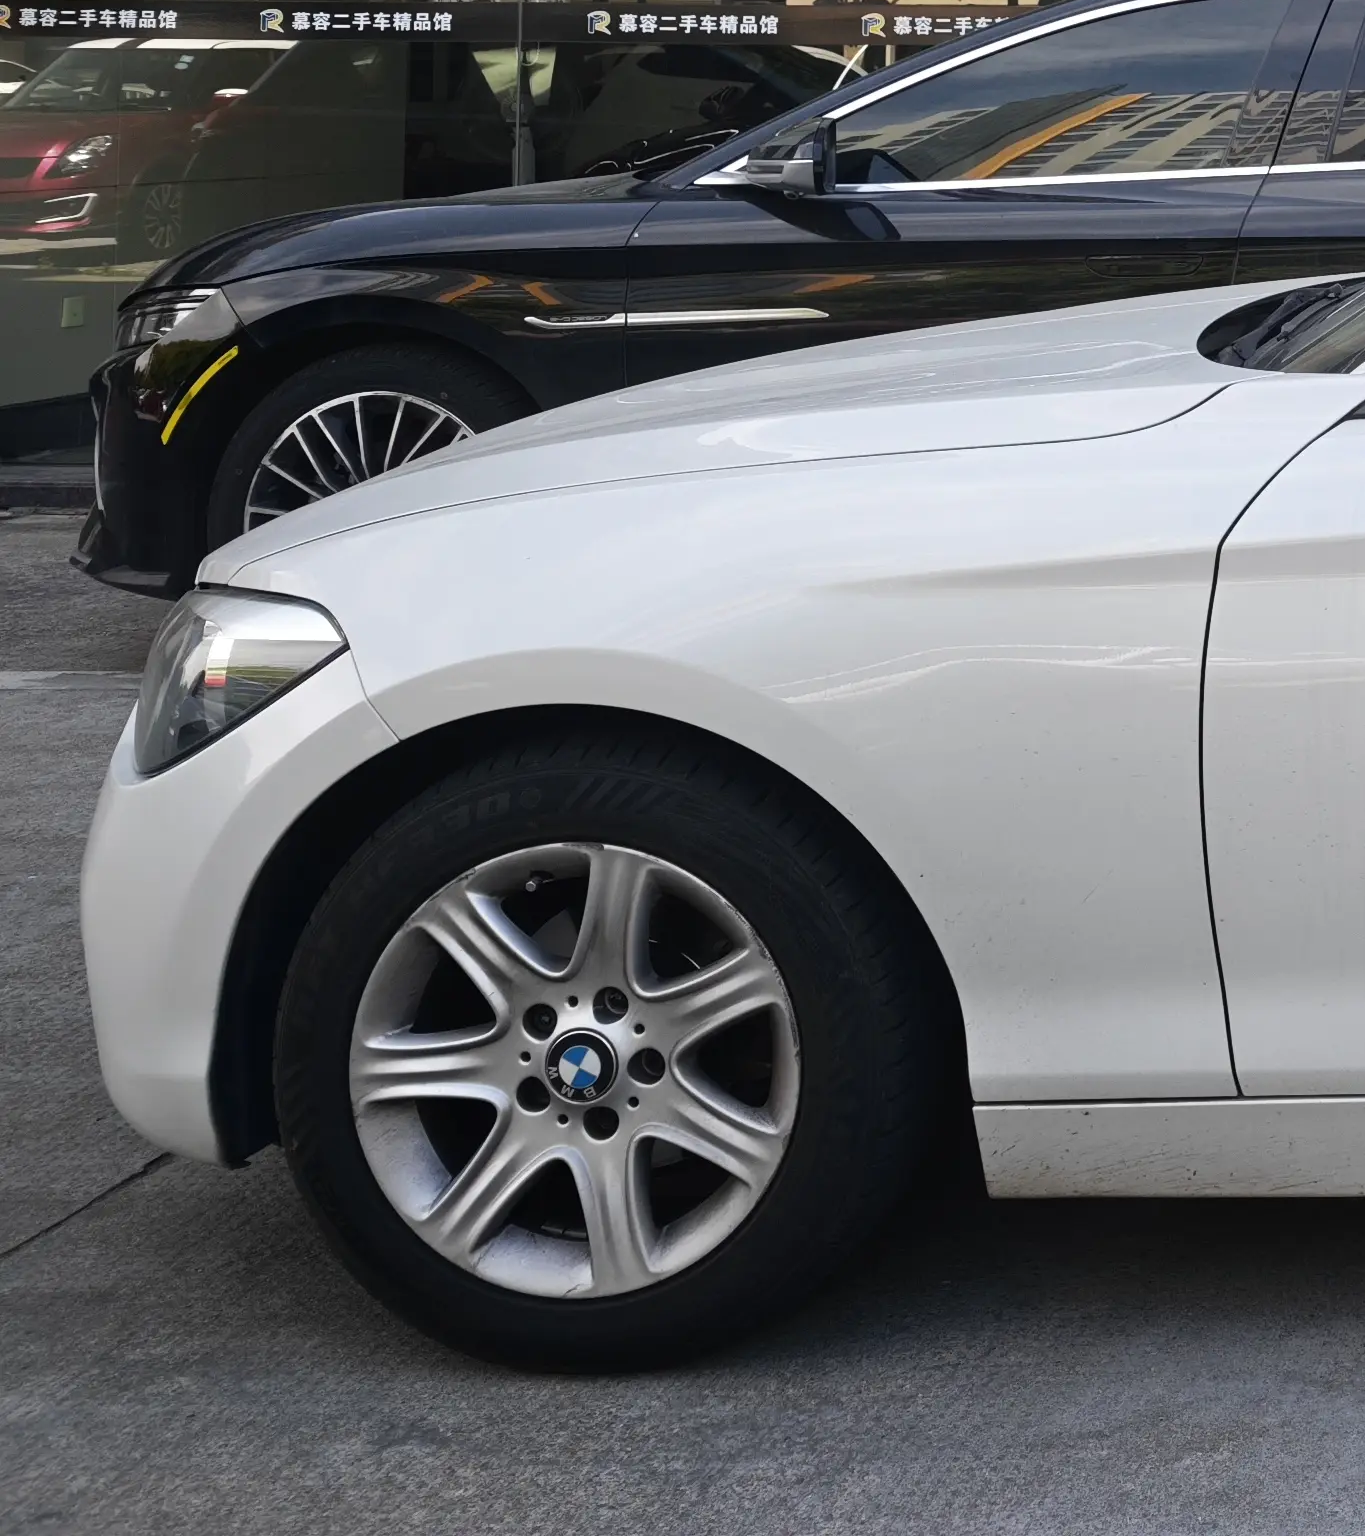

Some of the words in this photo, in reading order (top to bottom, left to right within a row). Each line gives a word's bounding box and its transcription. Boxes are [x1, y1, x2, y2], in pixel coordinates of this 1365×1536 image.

[18, 7, 178, 30] 慕容二手车精品馆
[291, 11, 453, 32] 慕容二手车精品馆
[618, 13, 779, 35] 慕容二手车精品馆
[893, 15, 1010, 36] 慕容二手车
